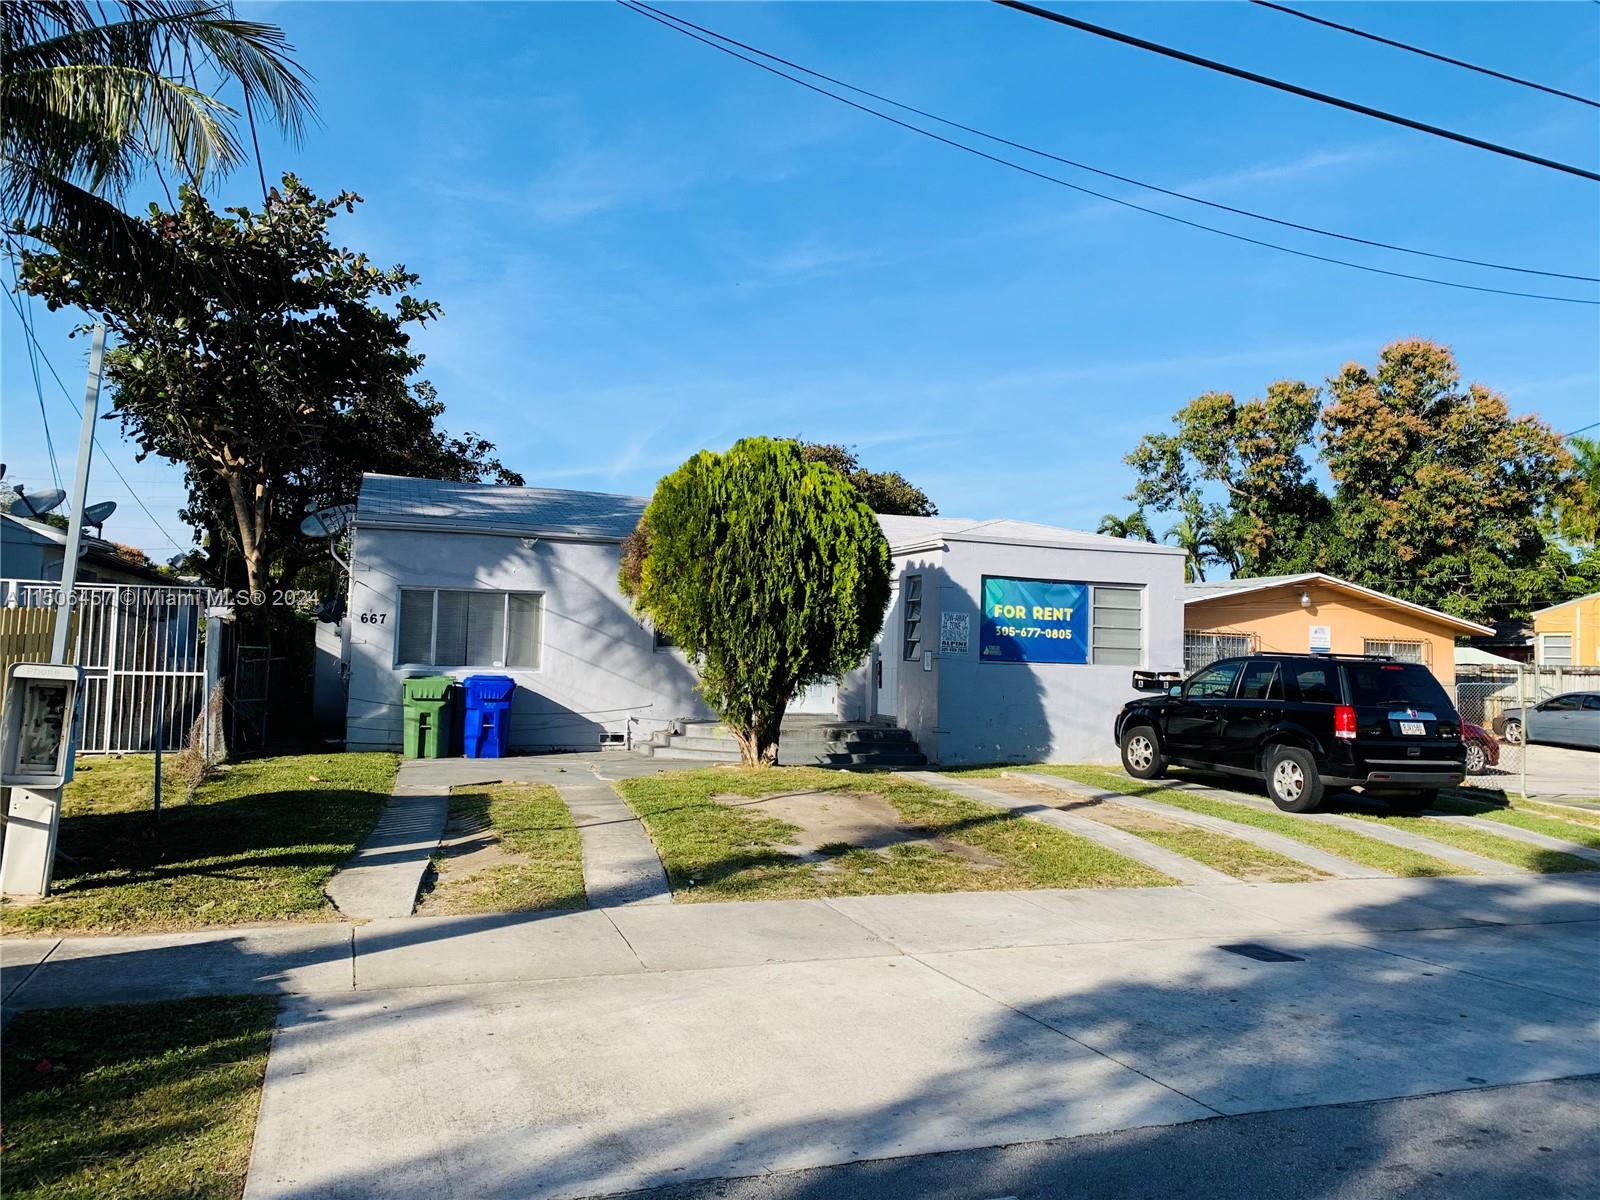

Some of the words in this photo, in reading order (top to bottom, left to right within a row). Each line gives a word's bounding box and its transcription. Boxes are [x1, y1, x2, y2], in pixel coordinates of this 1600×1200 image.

[360, 613, 387, 624] 667
[994, 604, 1026, 619] FOR
[1032, 606, 1073, 621] RENT
[995, 626, 1073, 640] 305-677-0805
